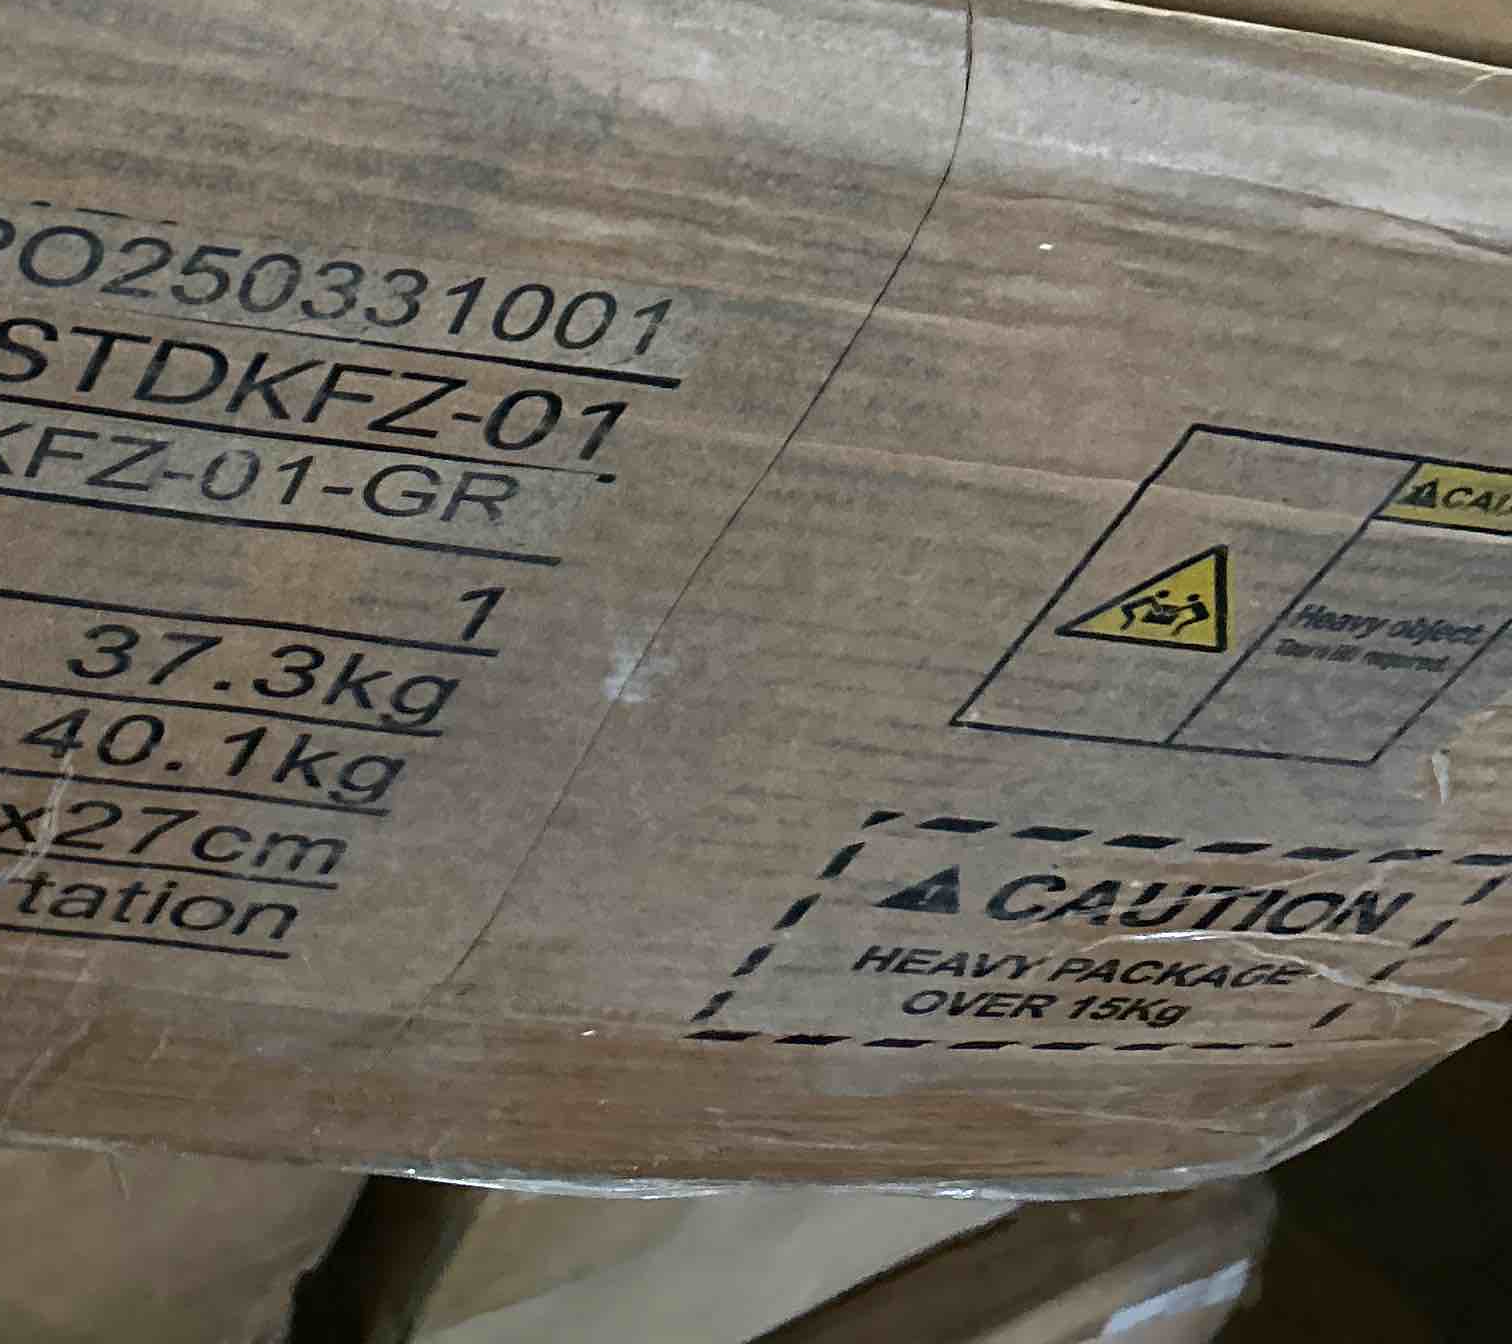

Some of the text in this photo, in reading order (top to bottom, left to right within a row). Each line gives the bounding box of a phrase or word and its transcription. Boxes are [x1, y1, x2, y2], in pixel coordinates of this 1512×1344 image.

[454, 584, 505, 643] 1
[65, 622, 461, 733] 37.3kg
[20, 706, 406, 807] 40.1kg
[988, 874, 1415, 935] CAUTION
[851, 944, 1312, 987] HEAVY PACKAGE
[900, 989, 1192, 1029] OVER 15Kg
